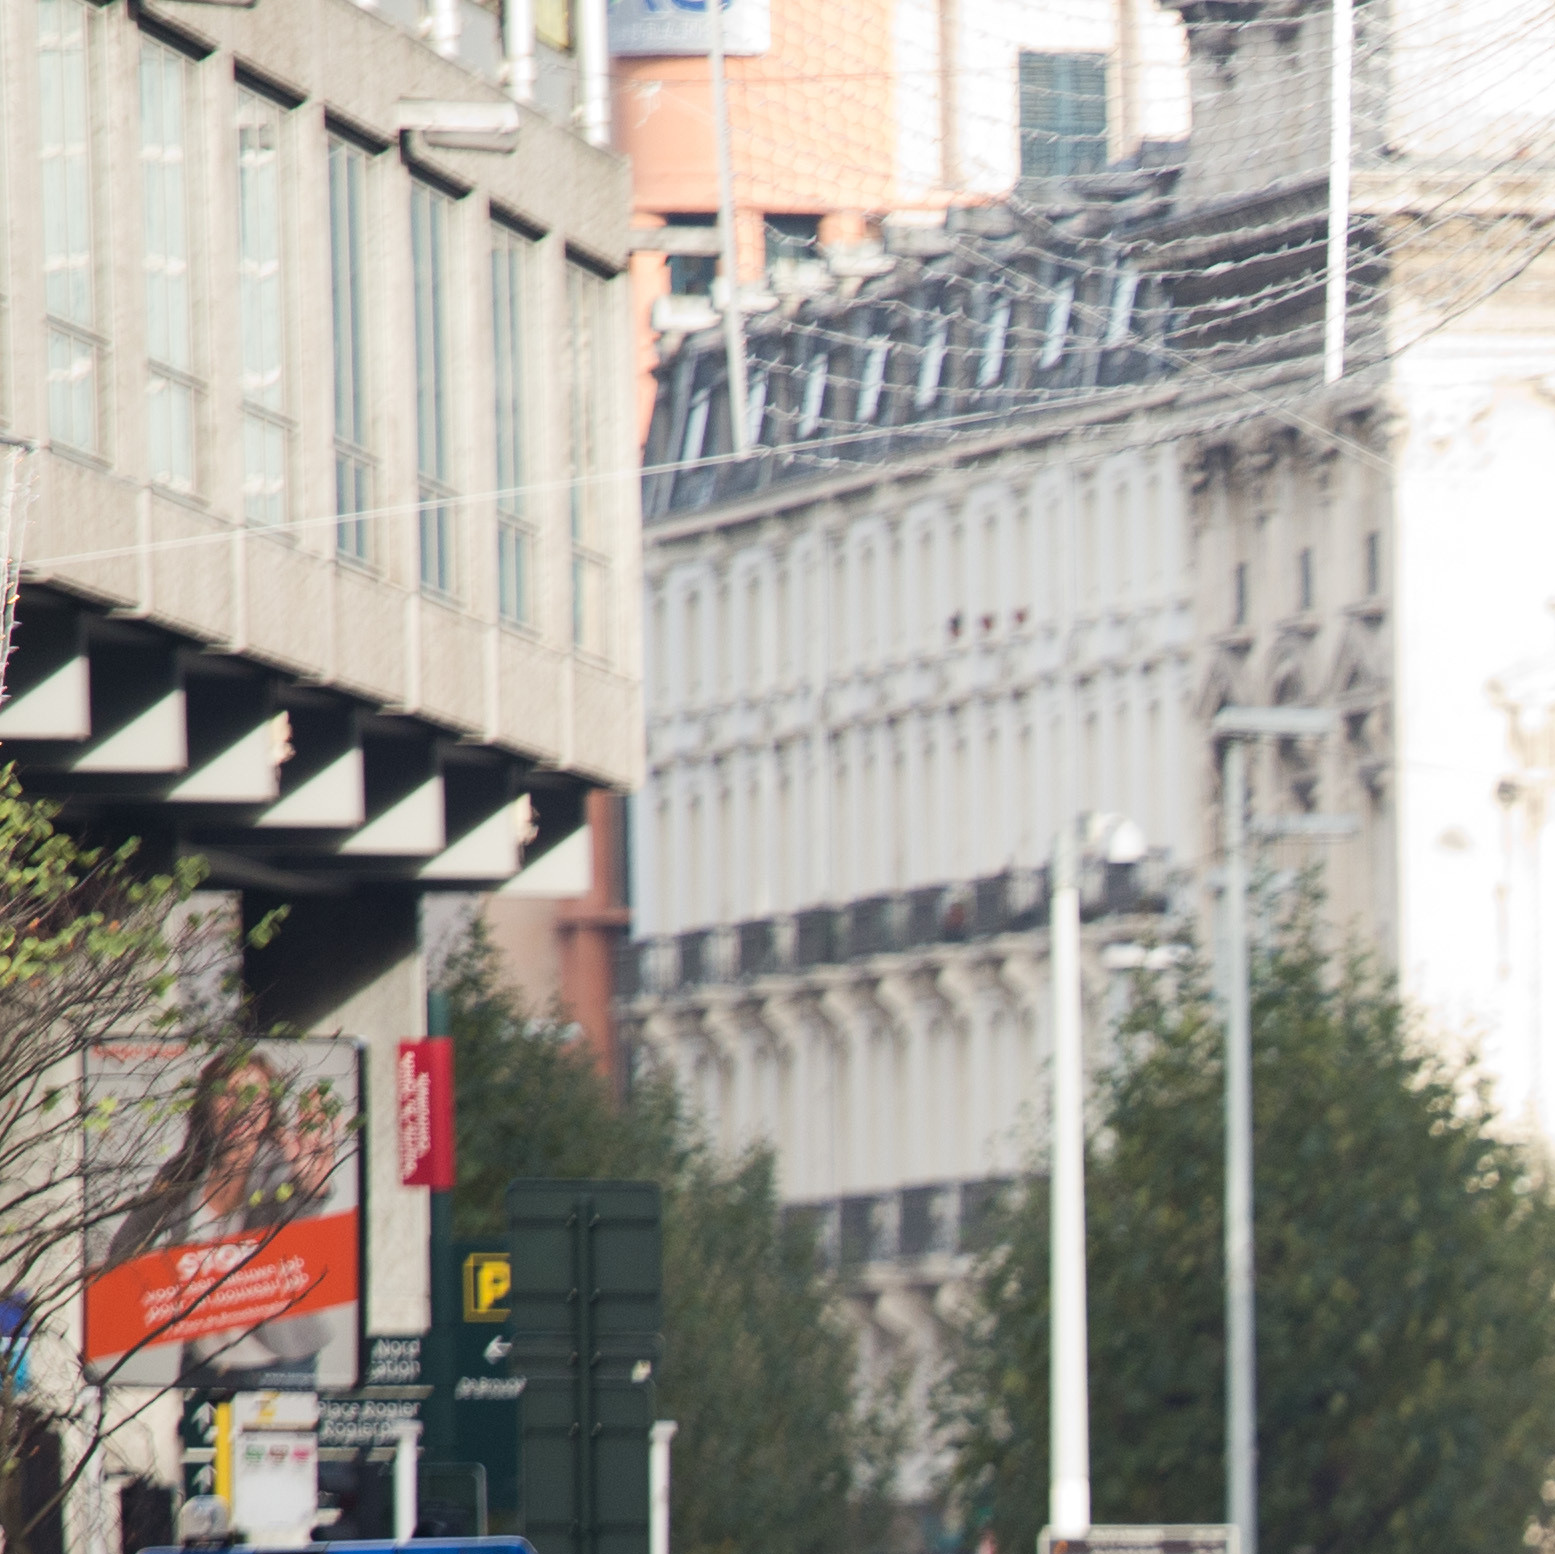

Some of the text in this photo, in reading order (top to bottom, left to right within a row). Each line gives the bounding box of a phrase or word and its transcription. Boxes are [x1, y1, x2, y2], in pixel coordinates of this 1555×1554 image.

[374, 1339, 421, 1358] Nord
[318, 1400, 421, 1420] Place Rogier
